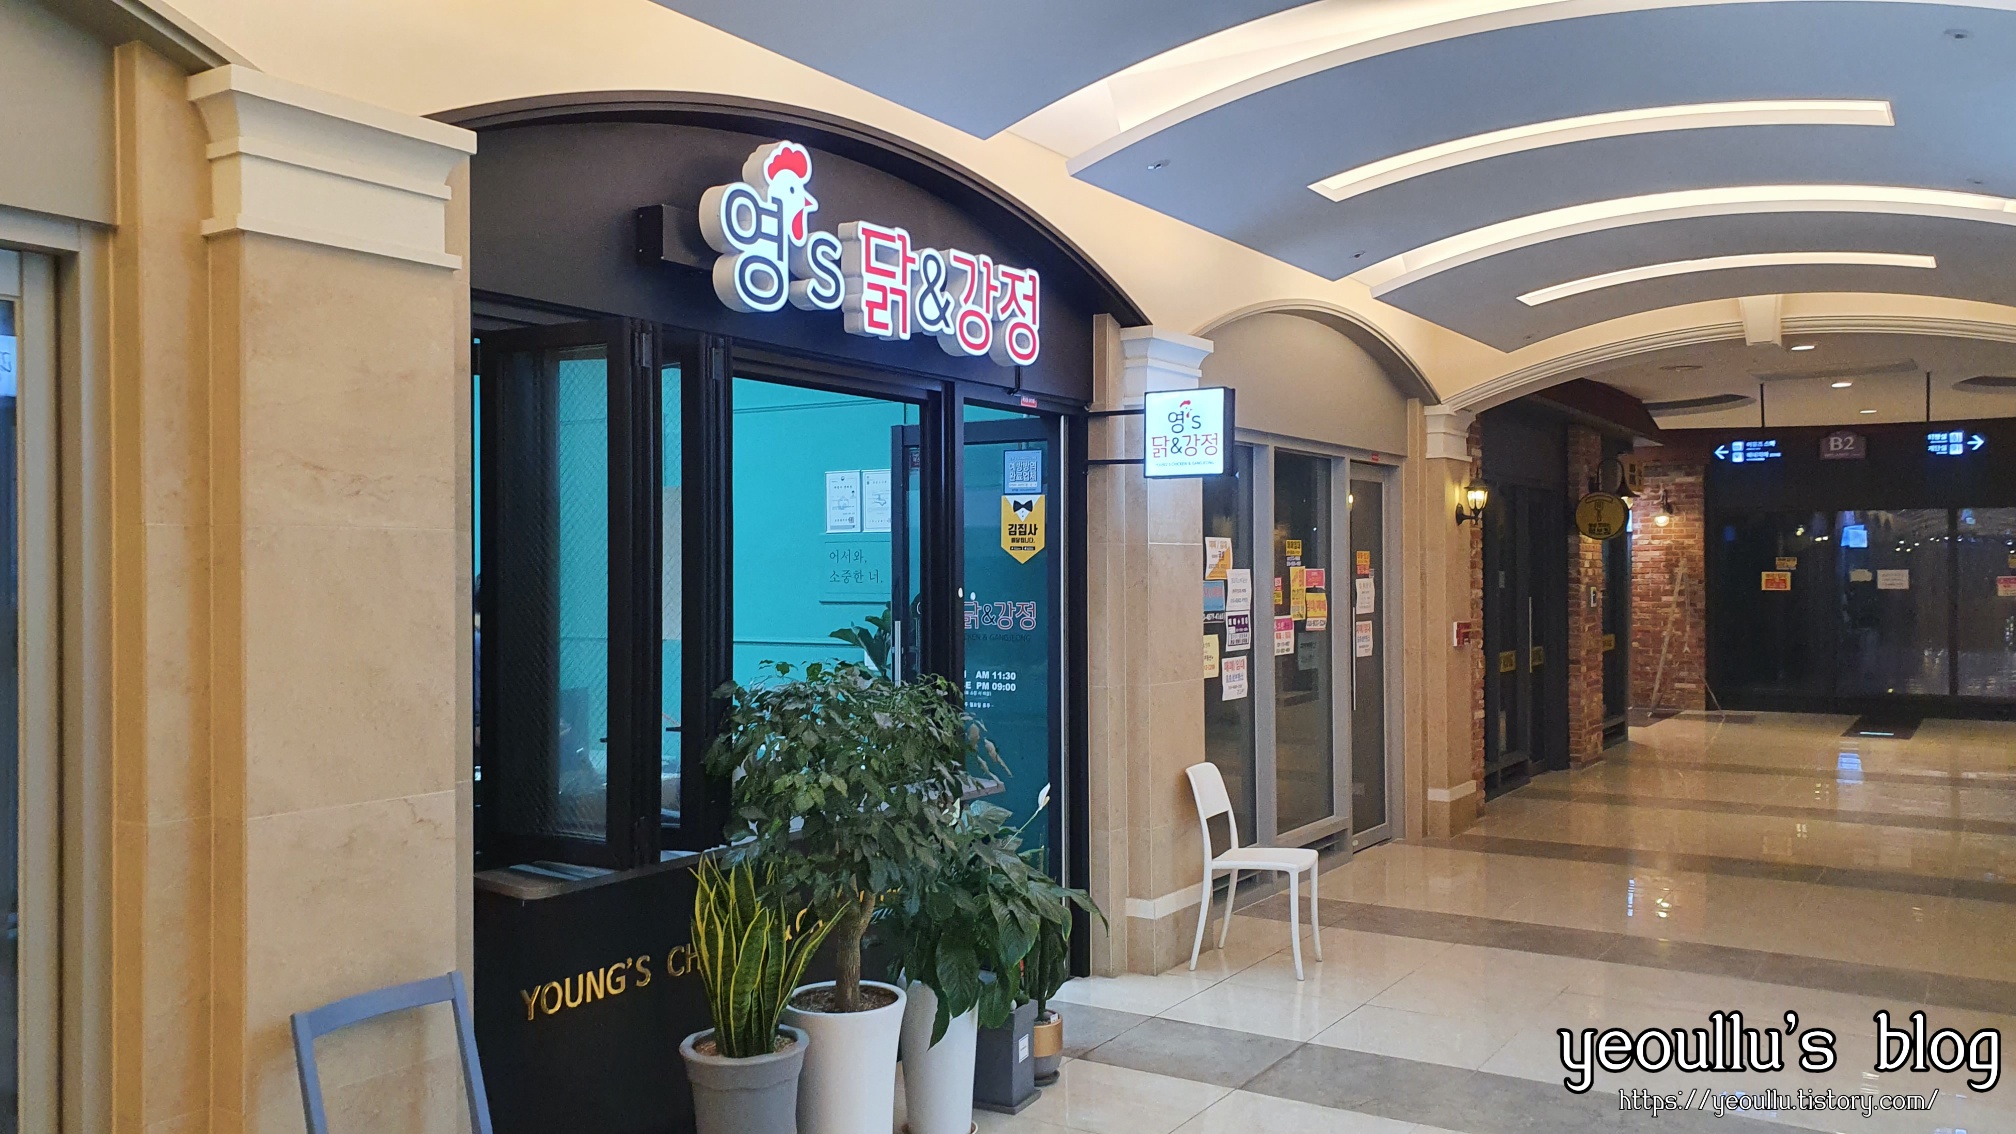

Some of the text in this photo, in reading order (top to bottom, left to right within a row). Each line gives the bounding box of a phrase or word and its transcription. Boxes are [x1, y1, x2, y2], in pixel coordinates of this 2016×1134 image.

[858, 222, 1041, 366] 닭&강정
[1151, 432, 1219, 459] 닭&강정
[1829, 436, 1855, 451] B2
[1008, 523, 1038, 536] 김집사
[829, 549, 867, 564] 어서와,
[829, 569, 883, 584] 소중한 너.
[975, 670, 990, 679] AM
[992, 671, 1016, 680] 11:30
[976, 681, 990, 690] PM
[991, 682, 1016, 691] 09:00
[519, 953, 652, 1021] YOUNG'S
